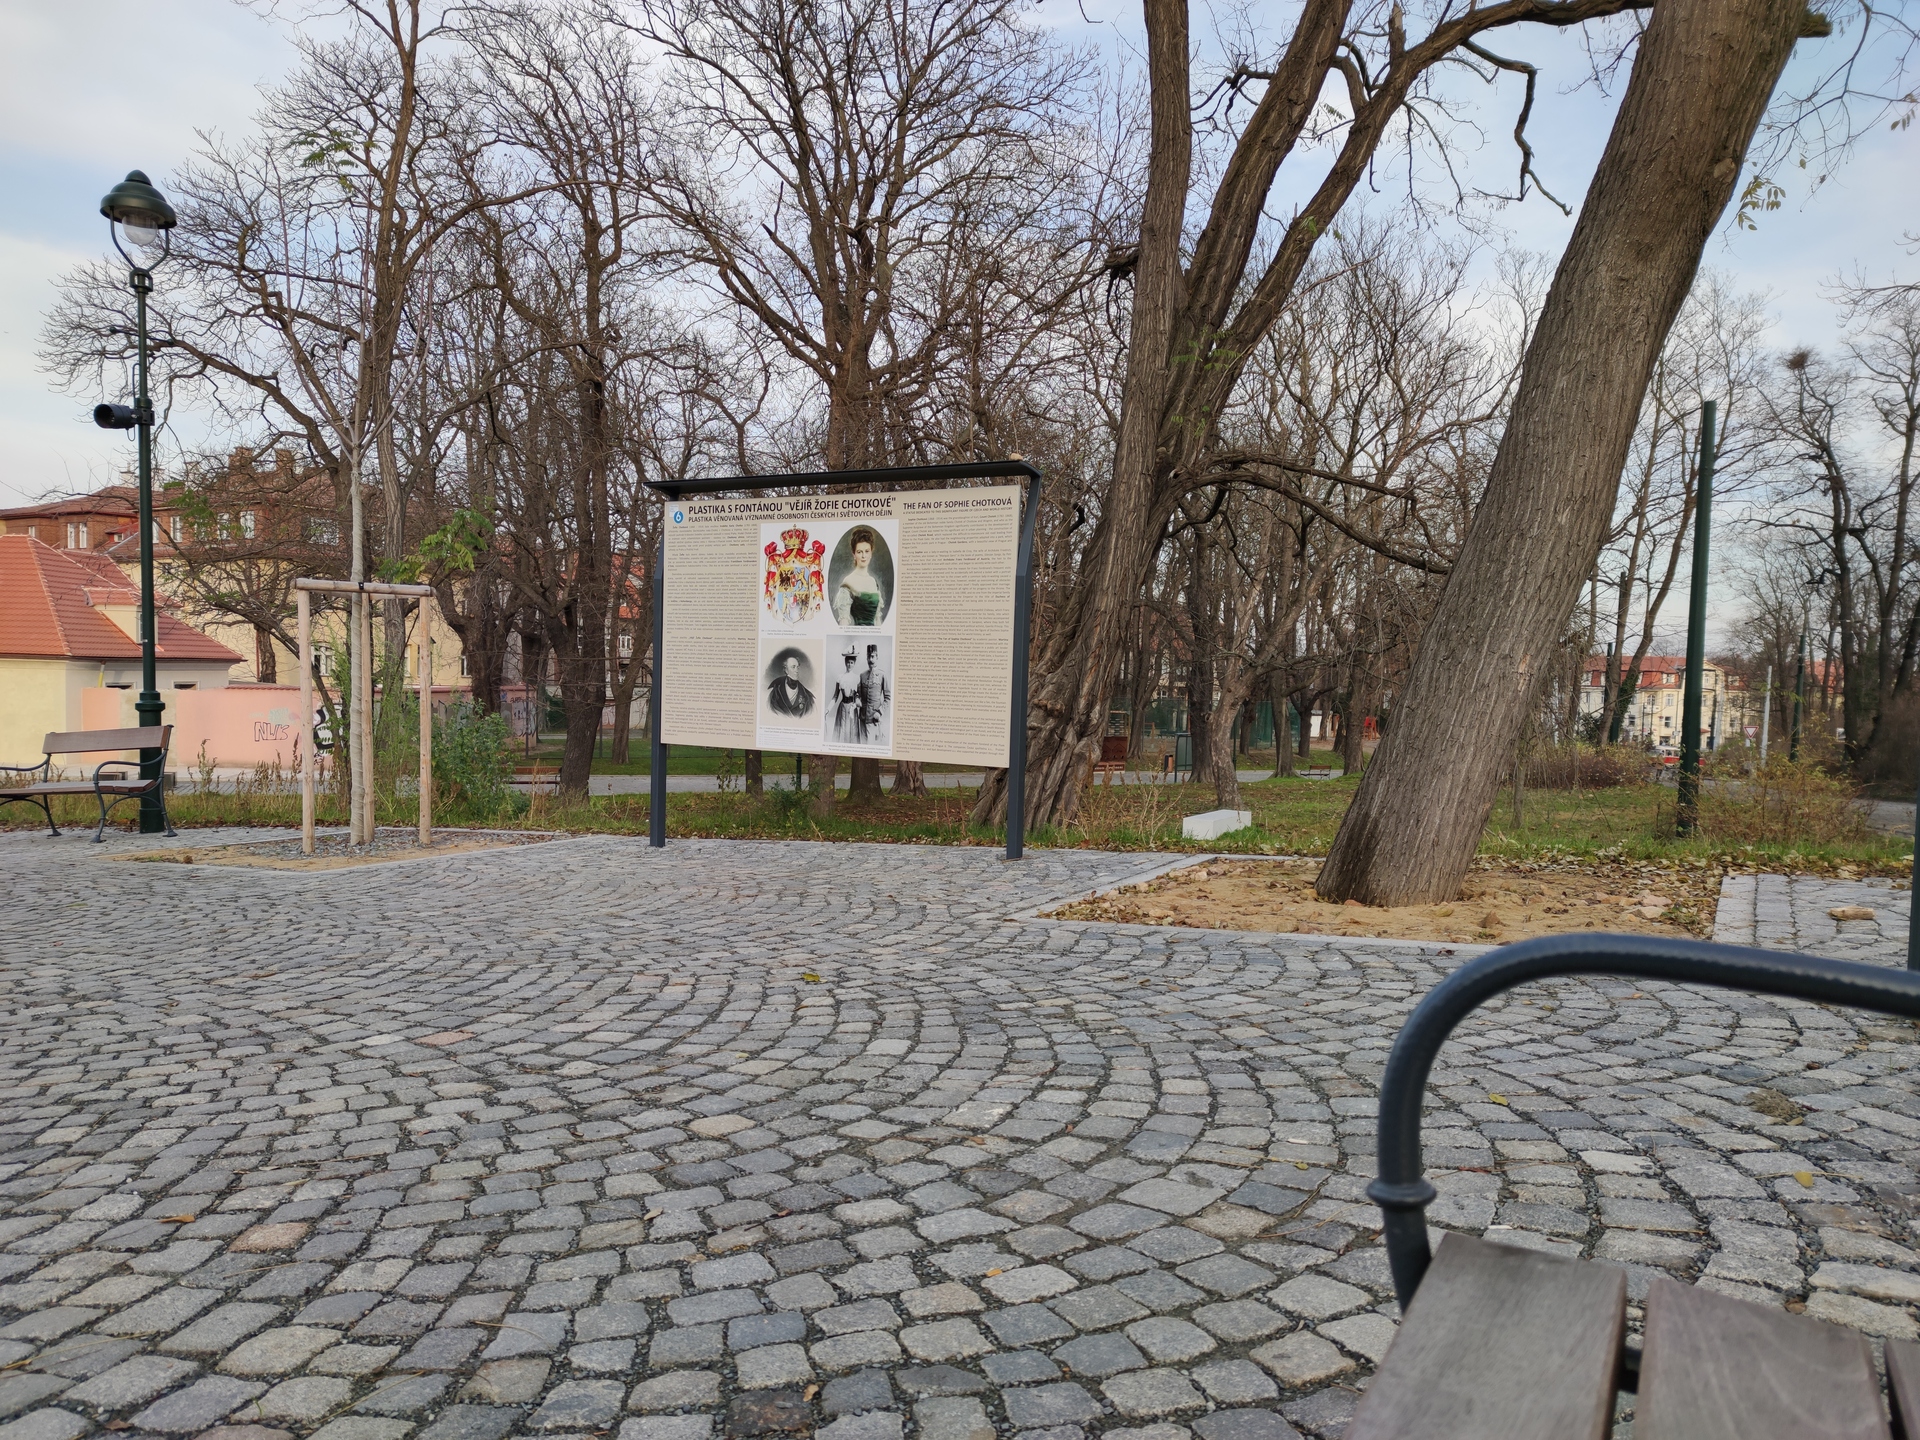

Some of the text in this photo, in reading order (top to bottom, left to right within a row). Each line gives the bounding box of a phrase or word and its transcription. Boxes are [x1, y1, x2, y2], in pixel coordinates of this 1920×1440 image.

[688, 505, 726, 515] PLASTIKA
[728, 504, 733, 514] S
[735, 501, 783, 513] FONTÁNOU
[784, 499, 812, 511] "VĚJÍŘ
[814, 499, 839, 510] ŽOFIE
[841, 495, 896, 509] CHOTKOVÉ"
[903, 496, 1012, 510] THE FAN OF SOPHIE CHOTKOVÁ
[688, 515, 713, 523] PLASTIKA
[714, 513, 744, 522] VĚNOVANÁ
[745, 512, 776, 521] VÝZNAMNÉ
[777, 511, 809, 519] OSOBNOSTI
[810, 510, 835, 519] ČESKÝCH
[840, 509, 874, 518] SVĚTOVÝCH
[875, 508, 893, 516] DĚJIN
